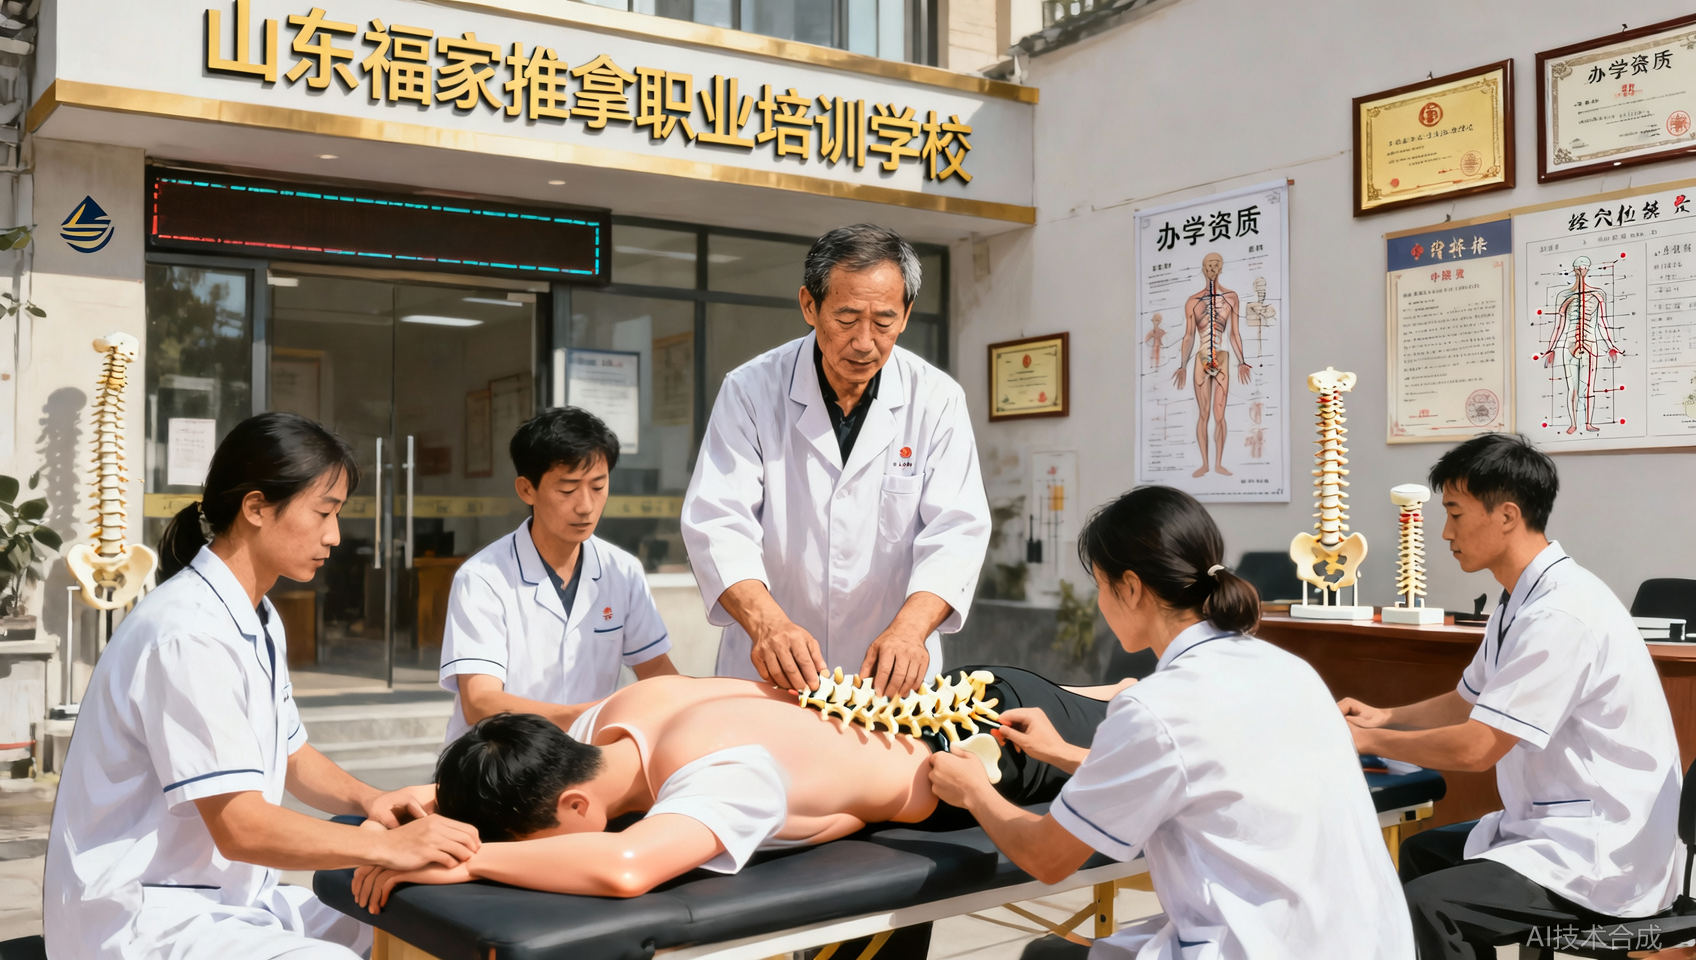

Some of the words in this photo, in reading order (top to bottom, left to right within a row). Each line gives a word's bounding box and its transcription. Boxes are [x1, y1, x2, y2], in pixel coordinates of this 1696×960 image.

[1587, 49, 1674, 84] 办学资质
[205, 0, 974, 184] 山东福家推拿职业培训学校
[1156, 204, 1262, 252] 办学资质
